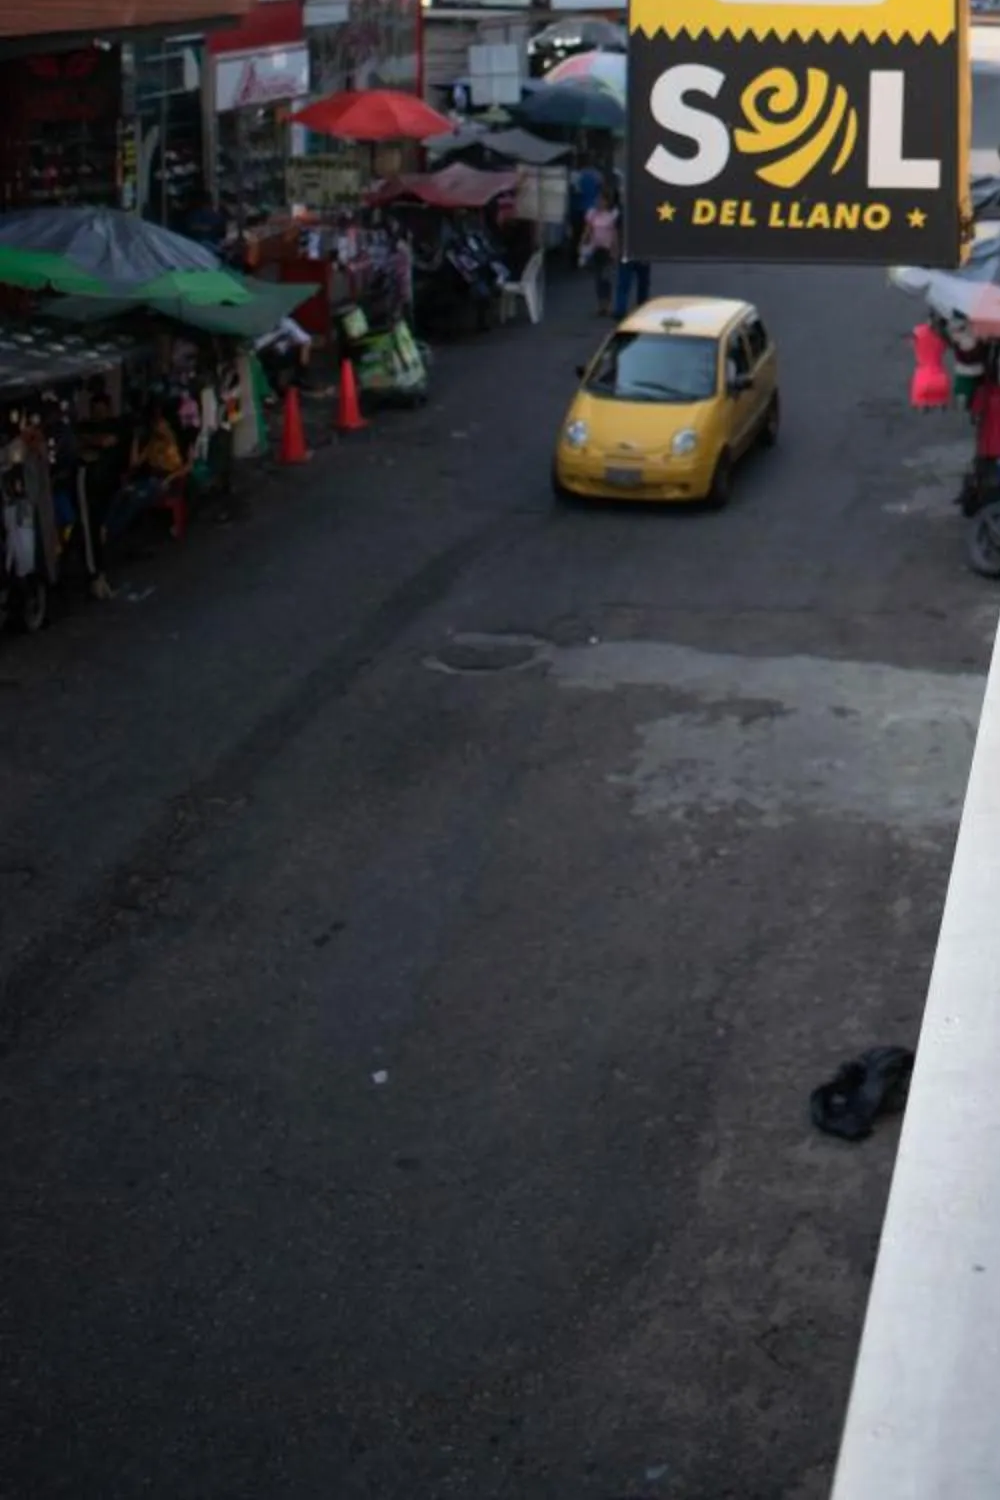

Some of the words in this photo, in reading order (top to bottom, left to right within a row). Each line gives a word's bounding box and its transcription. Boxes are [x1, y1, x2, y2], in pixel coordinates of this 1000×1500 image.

[644, 62, 941, 189] SOL
[691, 198, 756, 227] DEL
[768, 200, 892, 231] LLANO
